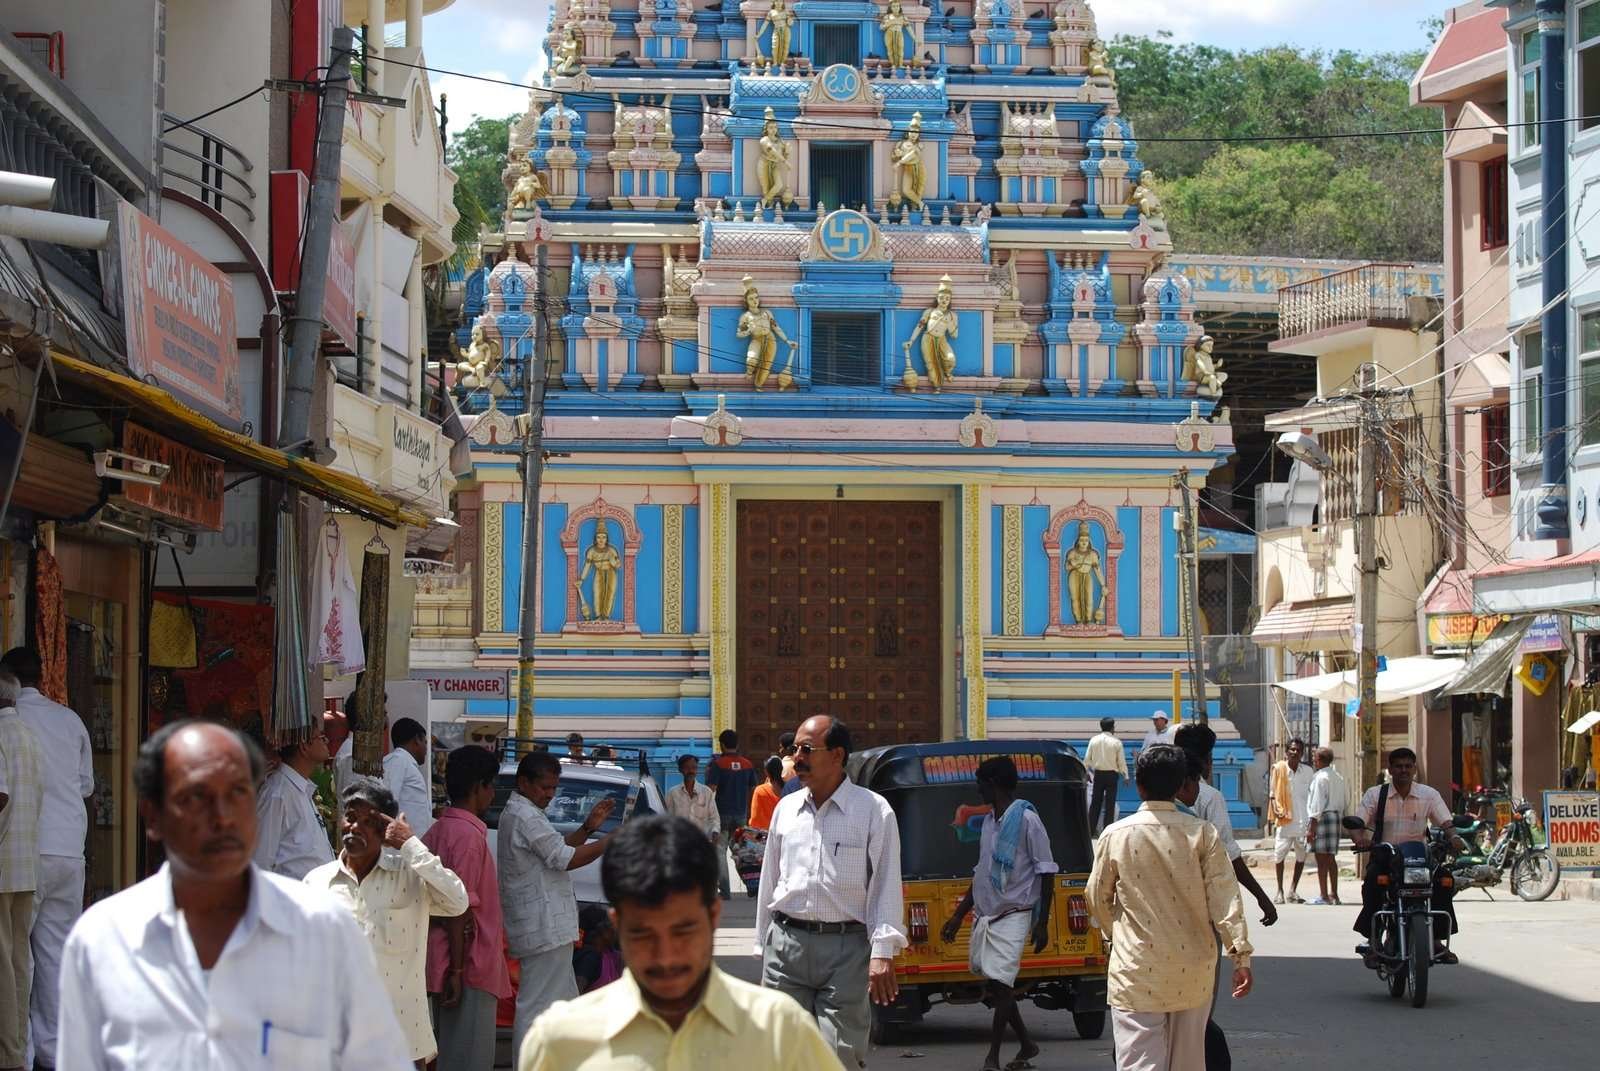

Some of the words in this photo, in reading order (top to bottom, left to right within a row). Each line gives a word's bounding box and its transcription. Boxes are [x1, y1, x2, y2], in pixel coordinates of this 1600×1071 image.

[444, 679, 500, 692] CHANGER
[1550, 804, 1598, 818] DELUXE
[1550, 822, 1600, 844] ROOMS
[1556, 846, 1595, 858] AVAILABLE
